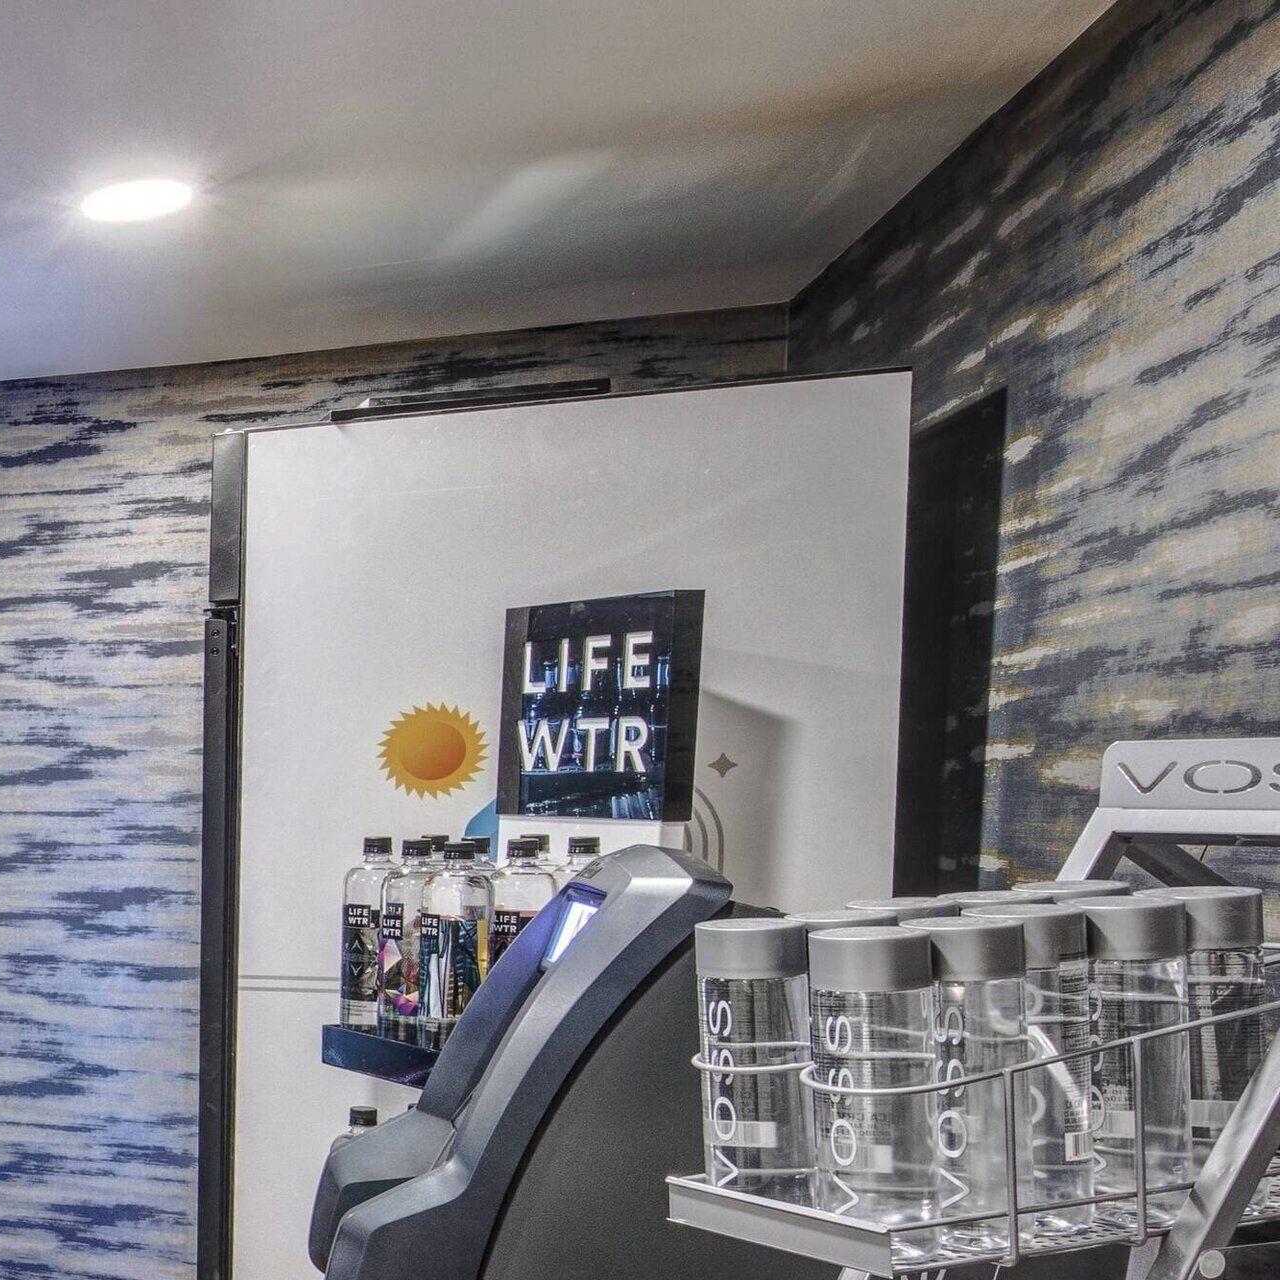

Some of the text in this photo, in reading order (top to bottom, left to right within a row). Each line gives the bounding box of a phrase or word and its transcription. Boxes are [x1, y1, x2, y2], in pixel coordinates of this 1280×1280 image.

[522, 629, 656, 694] LIFE
[516, 714, 649, 773] WTR
[1117, 759, 1280, 794] VO
[348, 906, 369, 917] LIFE
[348, 916, 369, 926] WTR
[382, 918, 402, 928] LIFE
[421, 917, 439, 927] LIFE
[494, 914, 518, 925] LIFE
[382, 928, 402, 937] WTR
[421, 926, 439, 936] WTR
[493, 923, 518, 934] WTR
[708, 999, 740, 1188] VOSS
[934, 1005, 971, 1210] VOSS
[825, 1015, 860, 1215] VOSS
